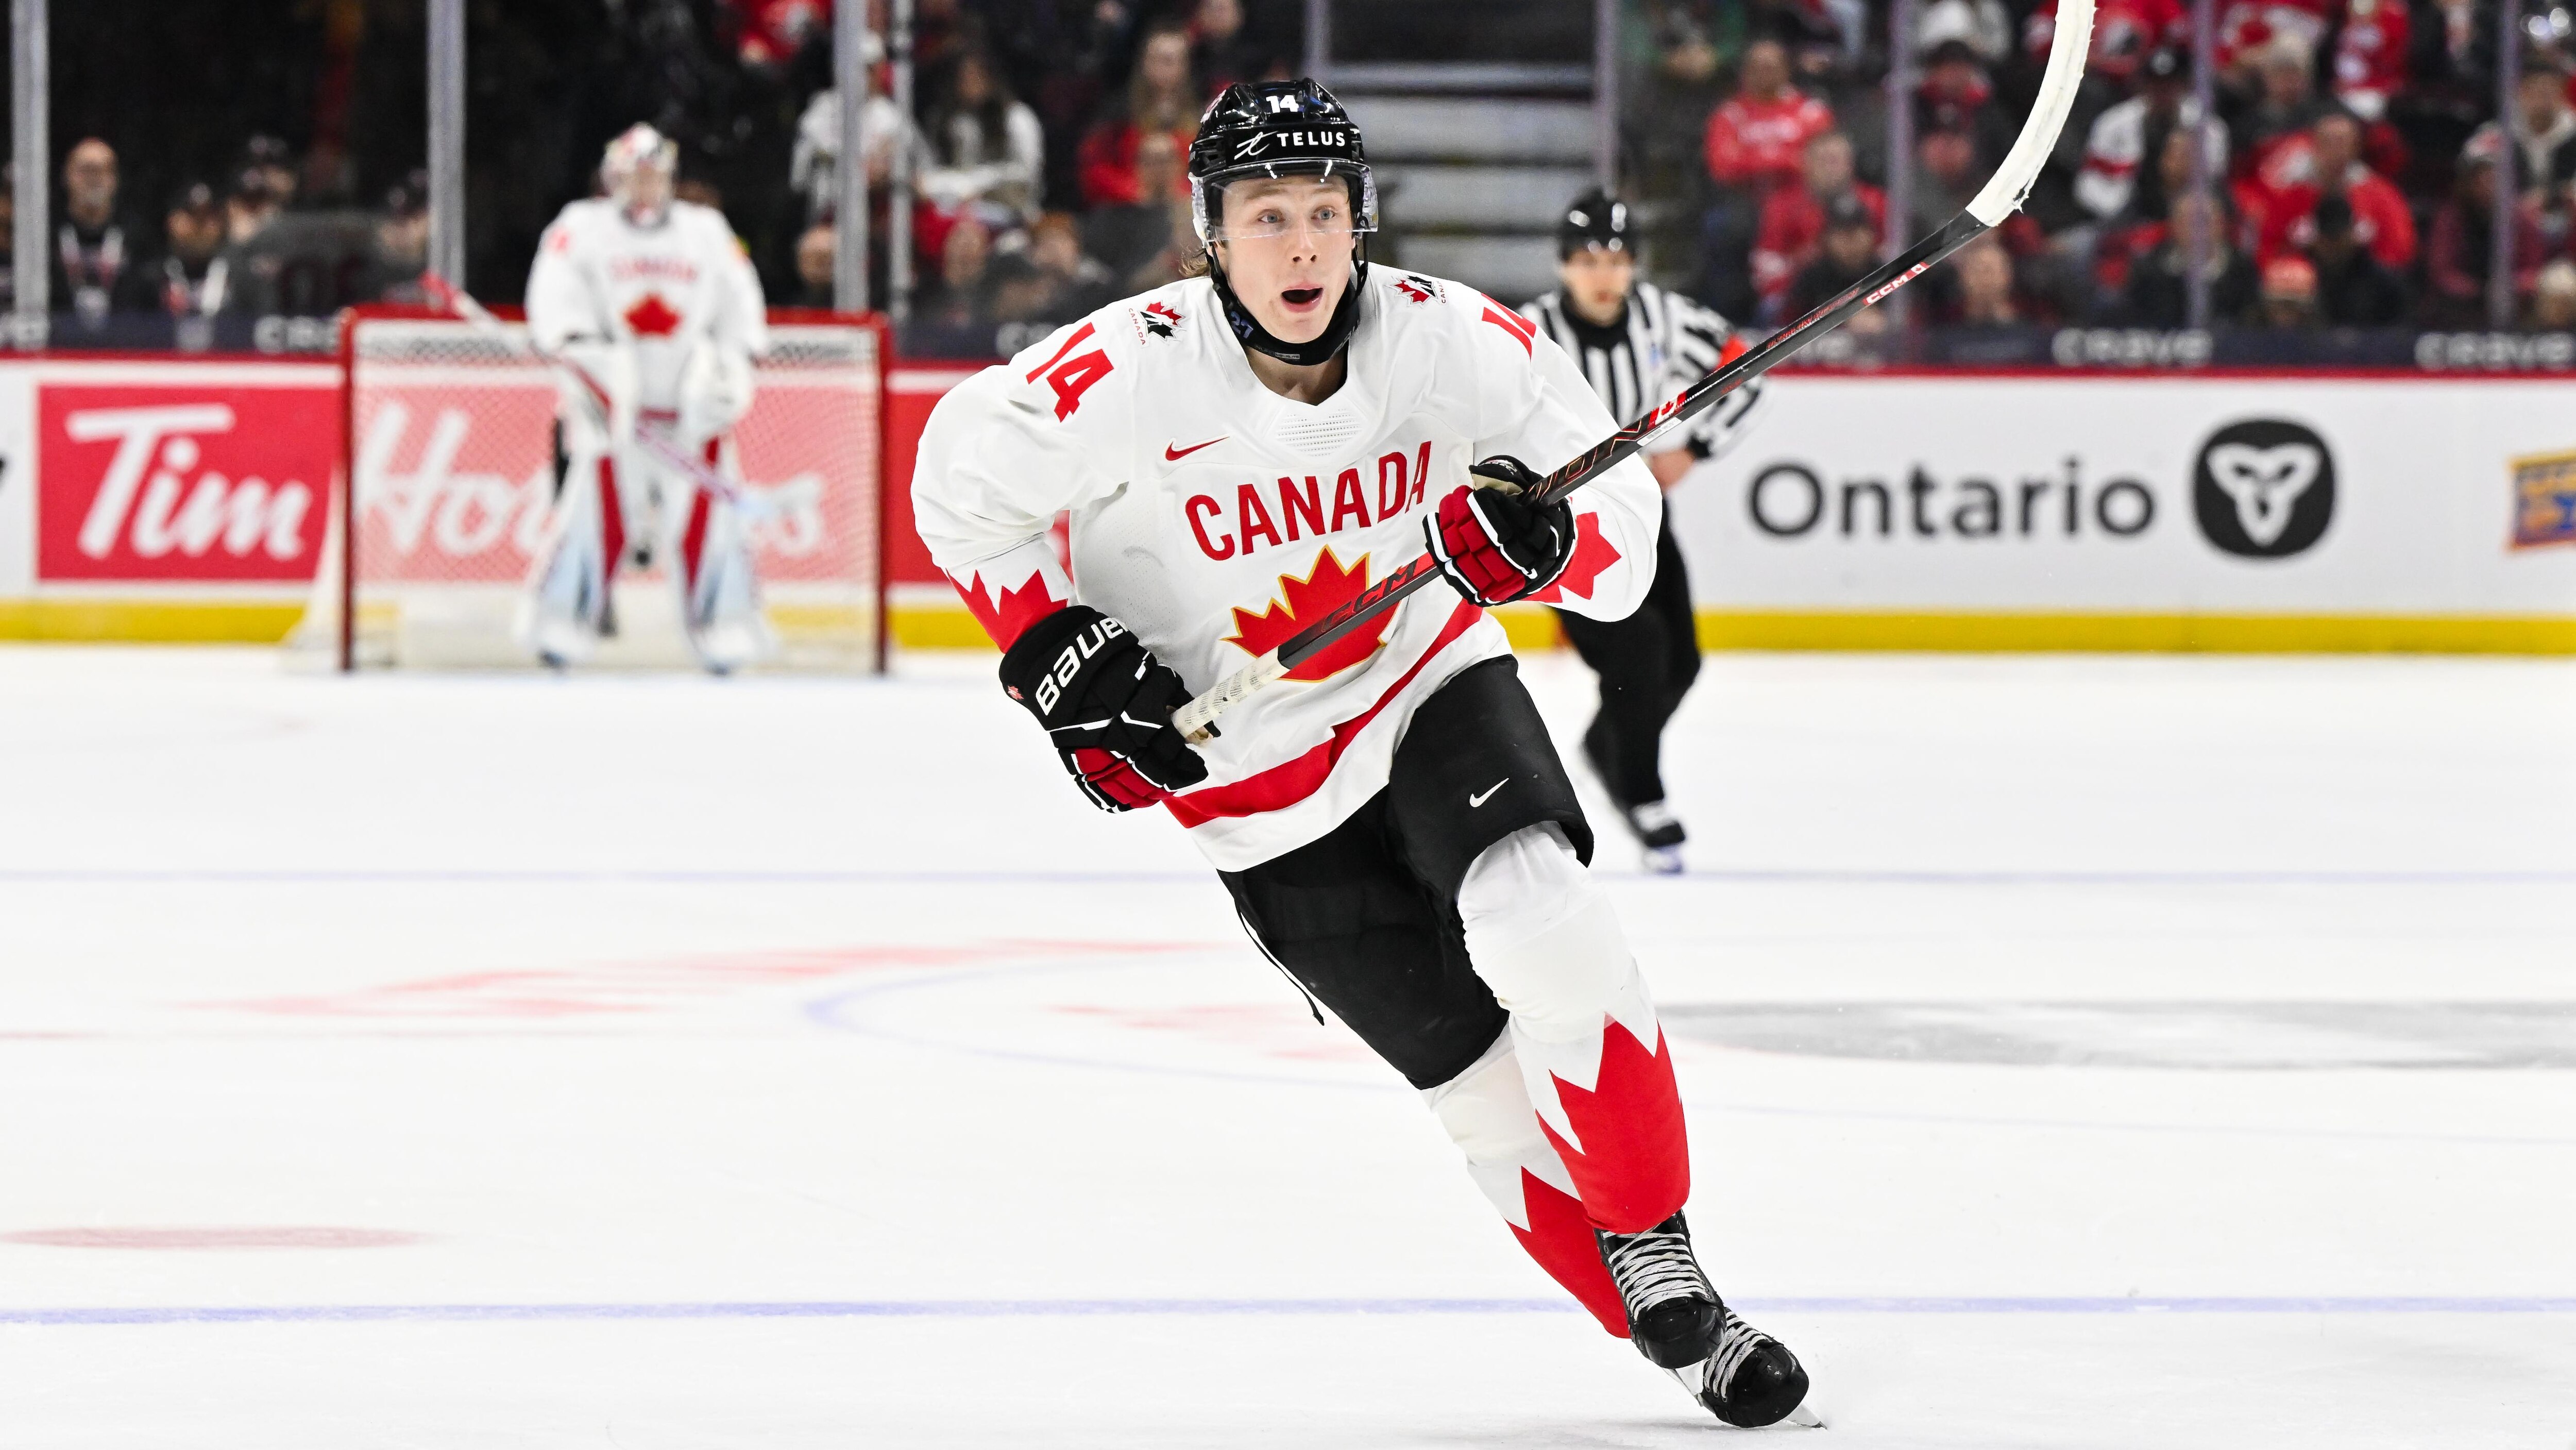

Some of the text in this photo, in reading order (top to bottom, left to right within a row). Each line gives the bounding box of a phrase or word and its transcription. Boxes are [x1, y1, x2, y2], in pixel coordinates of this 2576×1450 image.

[1265, 94, 1299, 114] 14
[1276, 131, 1346, 147] TELUS
[1128, 308, 1146, 345] CANADA
[1866, 275, 1909, 305] CCM
[1025, 322, 1114, 423] 14
[65, 402, 313, 561] Tim
[1185, 440, 1432, 561] CANADA
[1749, 456, 2156, 537] Ontario
[1321, 558, 1418, 632] CCM
